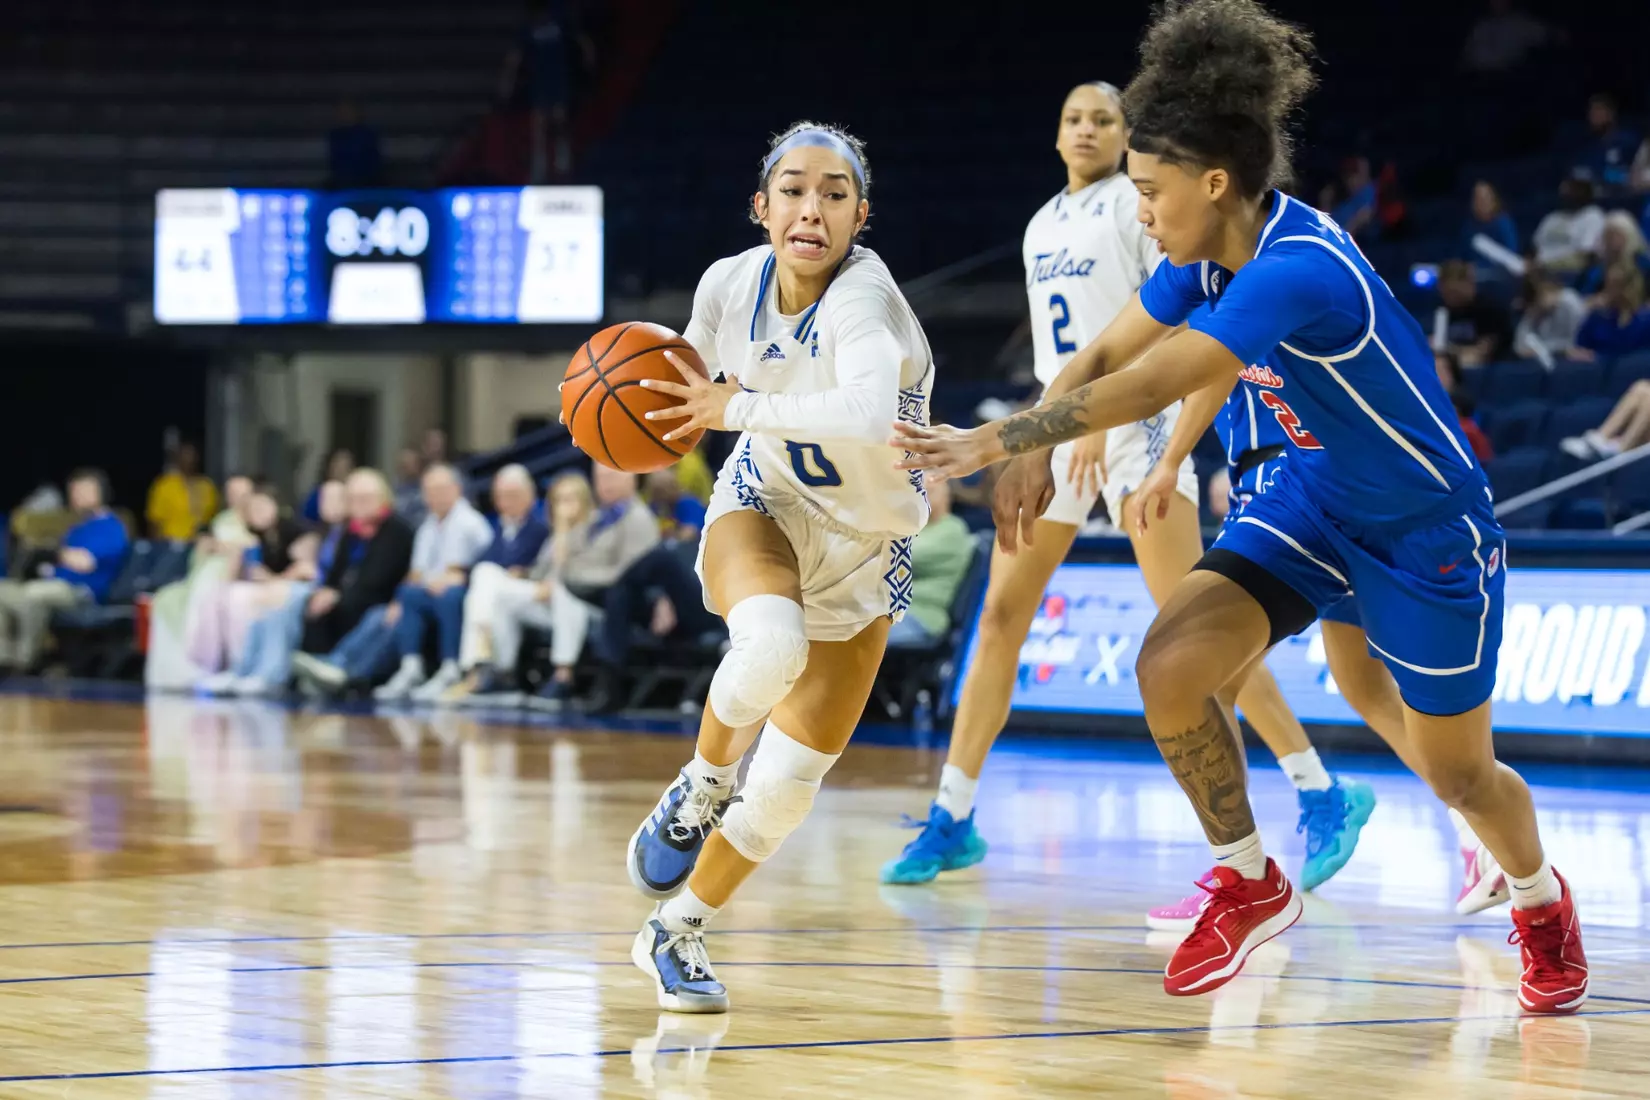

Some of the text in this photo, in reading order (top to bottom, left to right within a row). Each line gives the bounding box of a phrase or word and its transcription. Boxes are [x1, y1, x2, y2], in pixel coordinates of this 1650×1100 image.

[326, 207, 429, 257] 8:40
[1027, 248, 1096, 287] Tulsa
[1049, 293, 1077, 355] 2
[760, 352, 786, 362] adidas
[1258, 390, 1325, 450] 2
[783, 439, 843, 487] 0
[1084, 634, 1131, 686] X
[1492, 603, 1646, 706] ROUD
